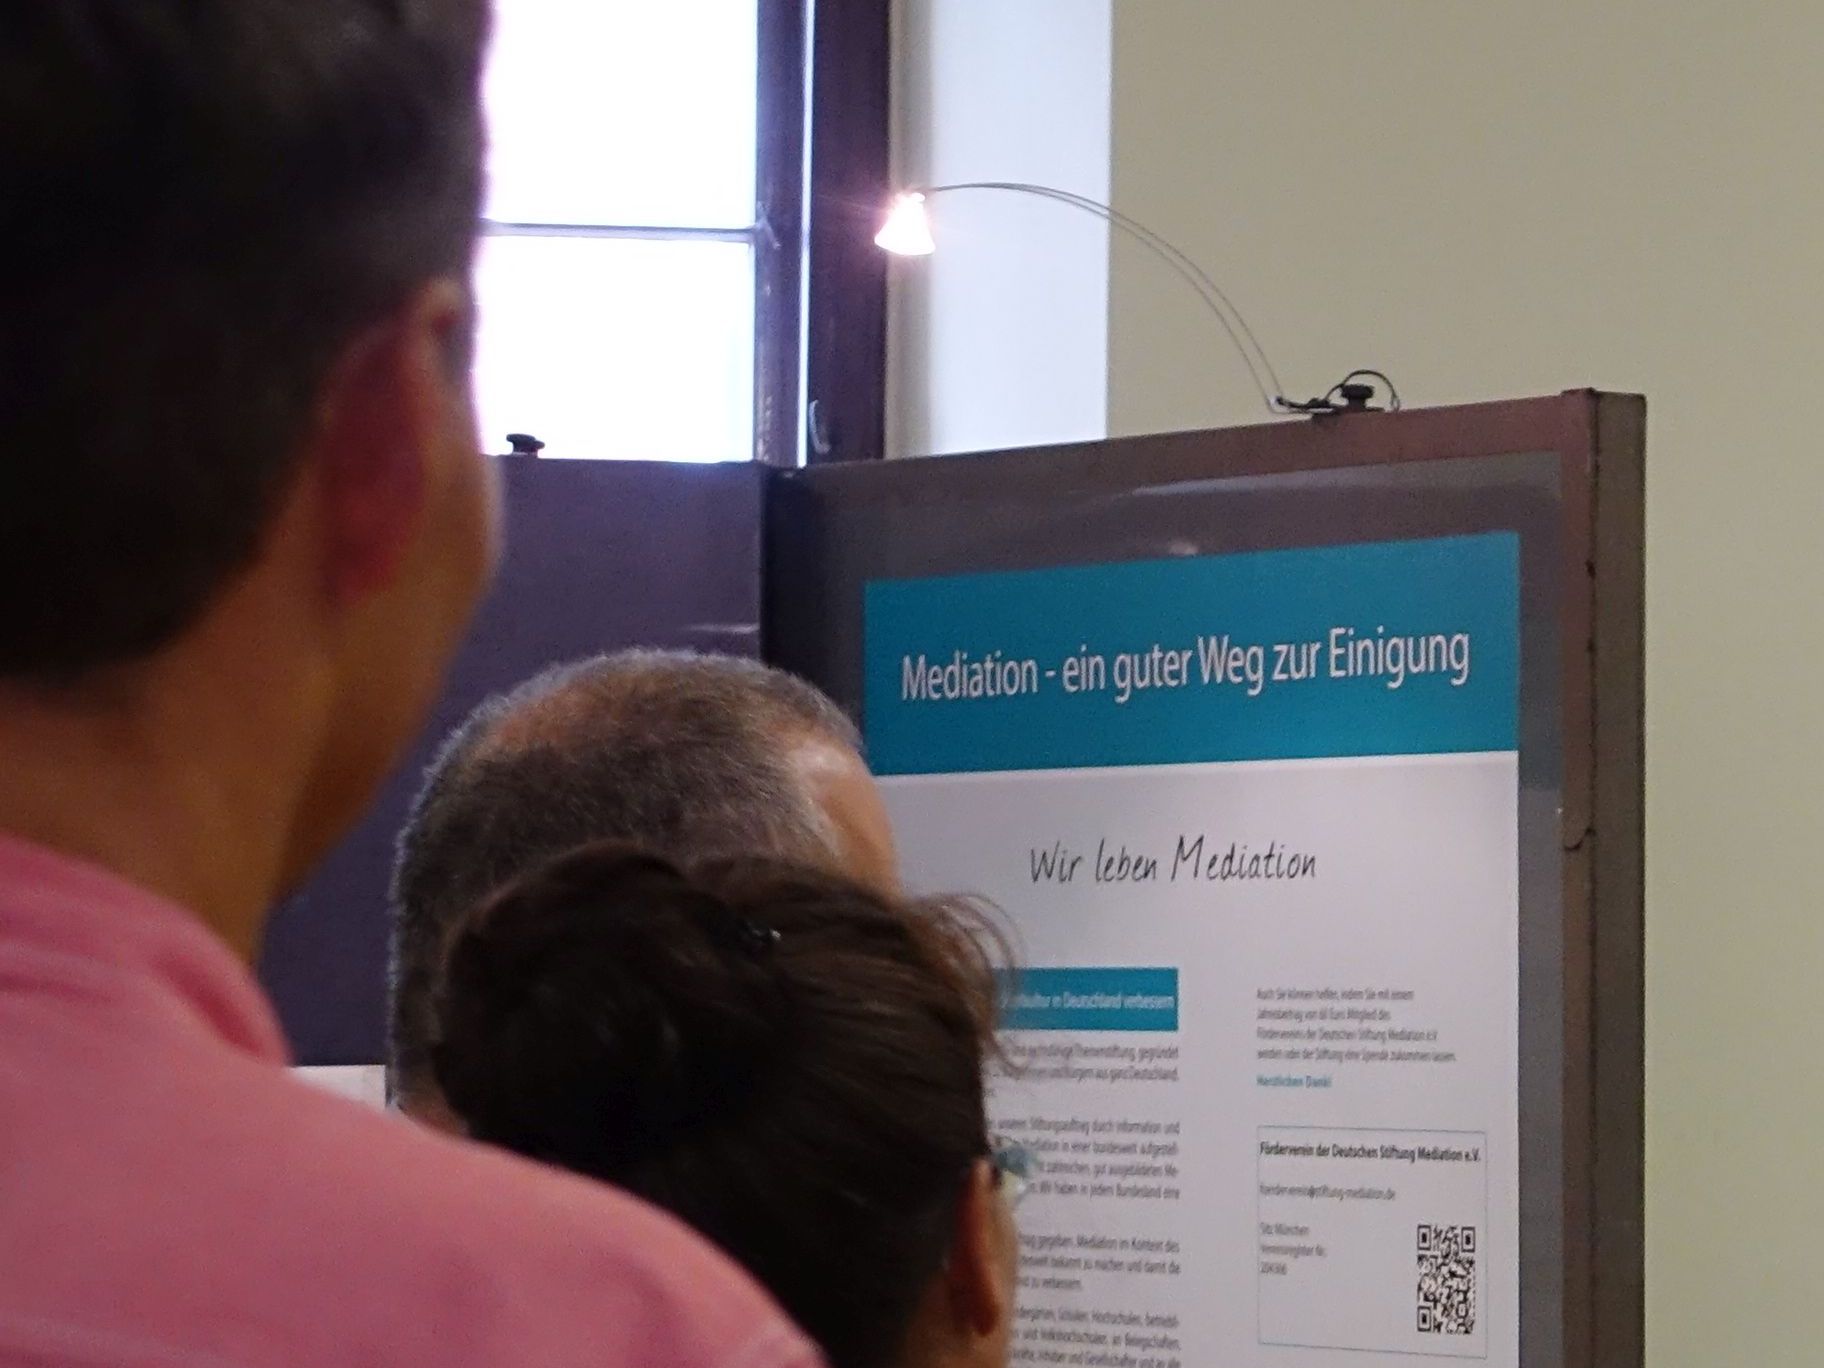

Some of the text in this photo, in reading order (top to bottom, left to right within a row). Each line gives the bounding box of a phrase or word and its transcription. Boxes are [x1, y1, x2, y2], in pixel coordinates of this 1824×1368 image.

[901, 650, 1038, 700] Mediation
[1063, 643, 1105, 694] ein
[1114, 644, 1191, 702] guter
[1198, 634, 1264, 696] Weg
[1272, 639, 1320, 679] zur
[1329, 625, 1471, 690] Einigung
[1030, 835, 1316, 883] Wir leben Mediation
